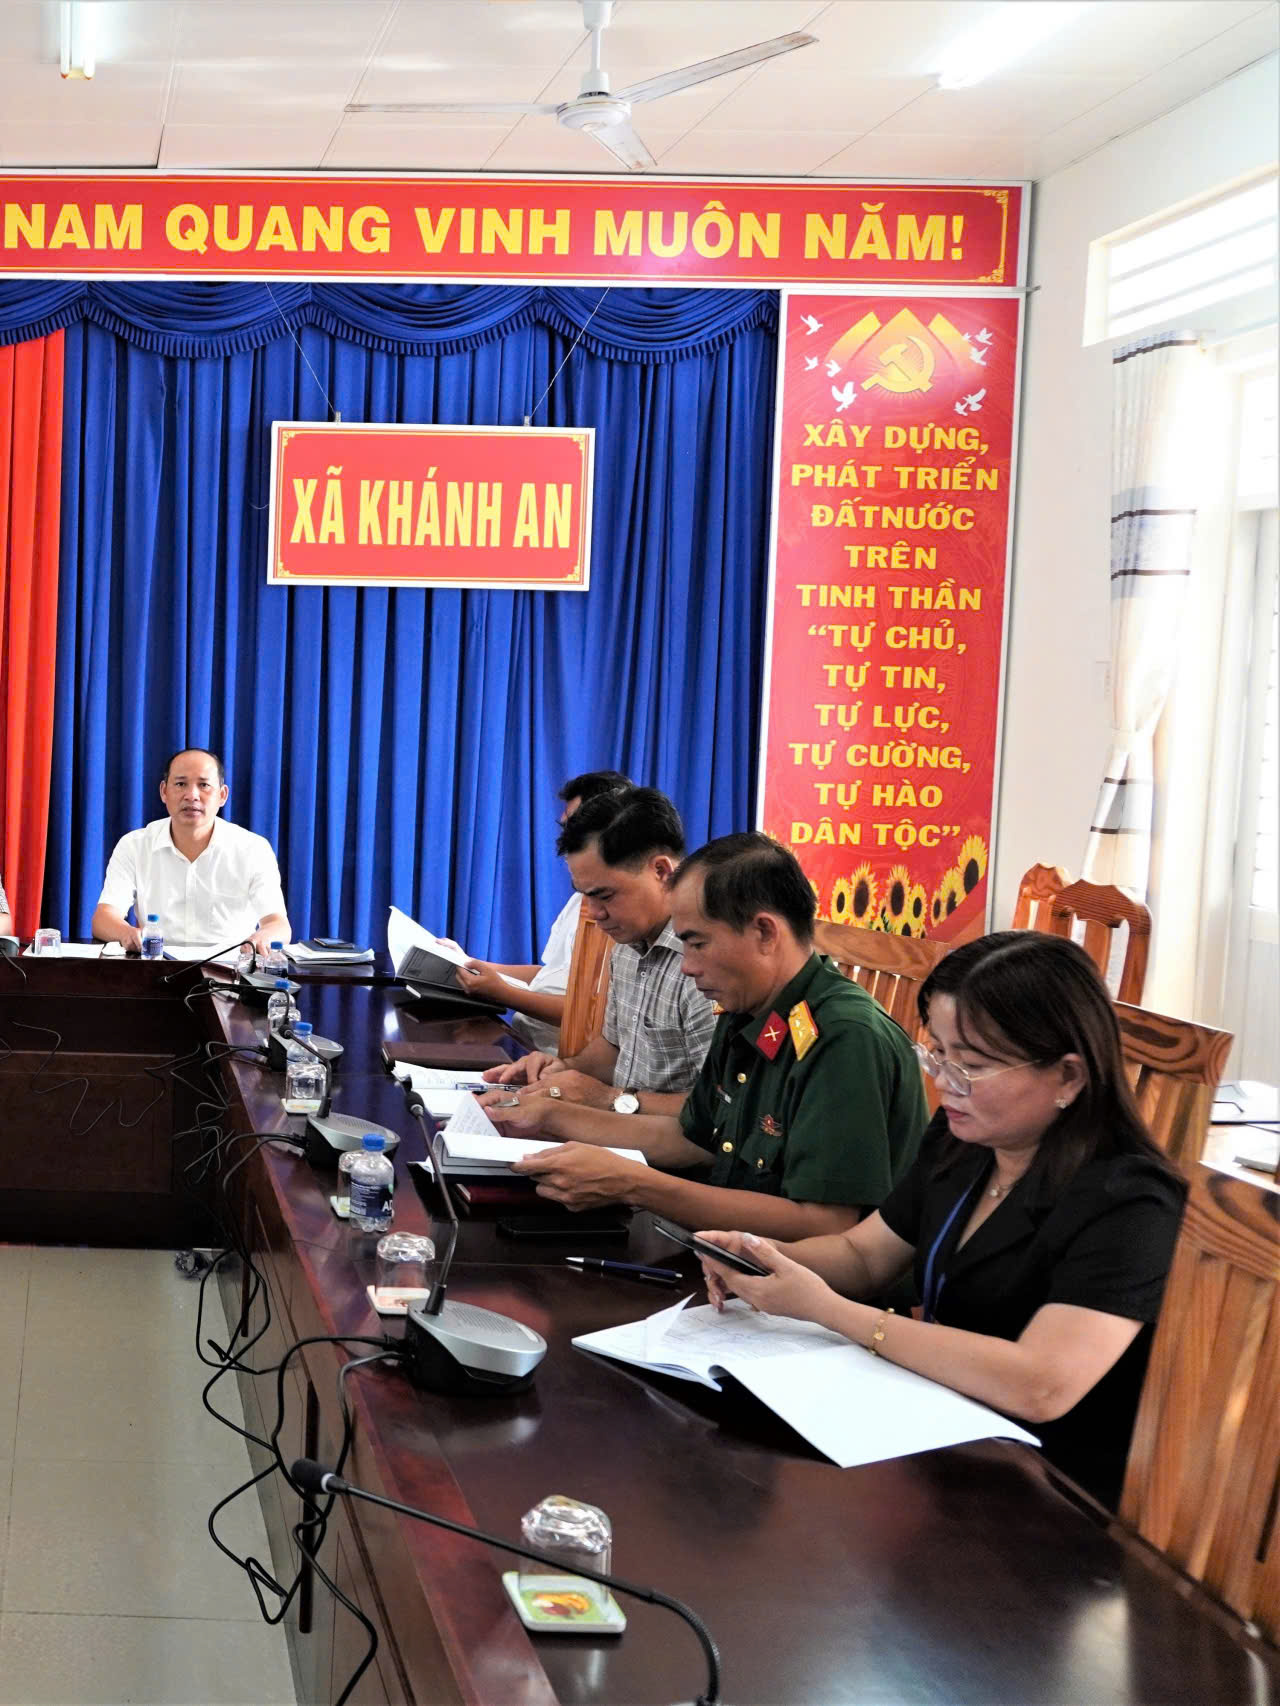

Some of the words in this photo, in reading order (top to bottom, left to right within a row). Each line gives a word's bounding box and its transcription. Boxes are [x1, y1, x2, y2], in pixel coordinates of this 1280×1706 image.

[4, 203, 143, 250] NAM
[165, 203, 391, 255] QUANG
[414, 207, 571, 256] VINH
[593, 200, 782, 259] MUÔN
[804, 202, 965, 261] NĂM!
[802, 418, 872, 448] XÂY
[883, 422, 990, 456] DỰNG,
[790, 459, 883, 489] PHÁT
[893, 456, 999, 491] TRIỂN
[289, 464, 346, 545] XÃ
[357, 465, 503, 547] KHÁNH
[512, 482, 573, 549] AN
[843, 540, 938, 570] TRÊN
[795, 583, 876, 608] TINH
[887, 577, 982, 611] THẦN
[884, 618, 968, 655] CHỦ,
[821, 660, 872, 693] TỰ
[879, 665, 947, 695] TIN,
[813, 700, 864, 732] TỰ
[872, 701, 951, 734] LỰC,
[787, 739, 838, 771] TỰ
[845, 739, 972, 774] CƯỜNG,
[813, 779, 863, 811] TỰ
[871, 778, 944, 808] HÀO
[790, 816, 862, 845] DÂN
